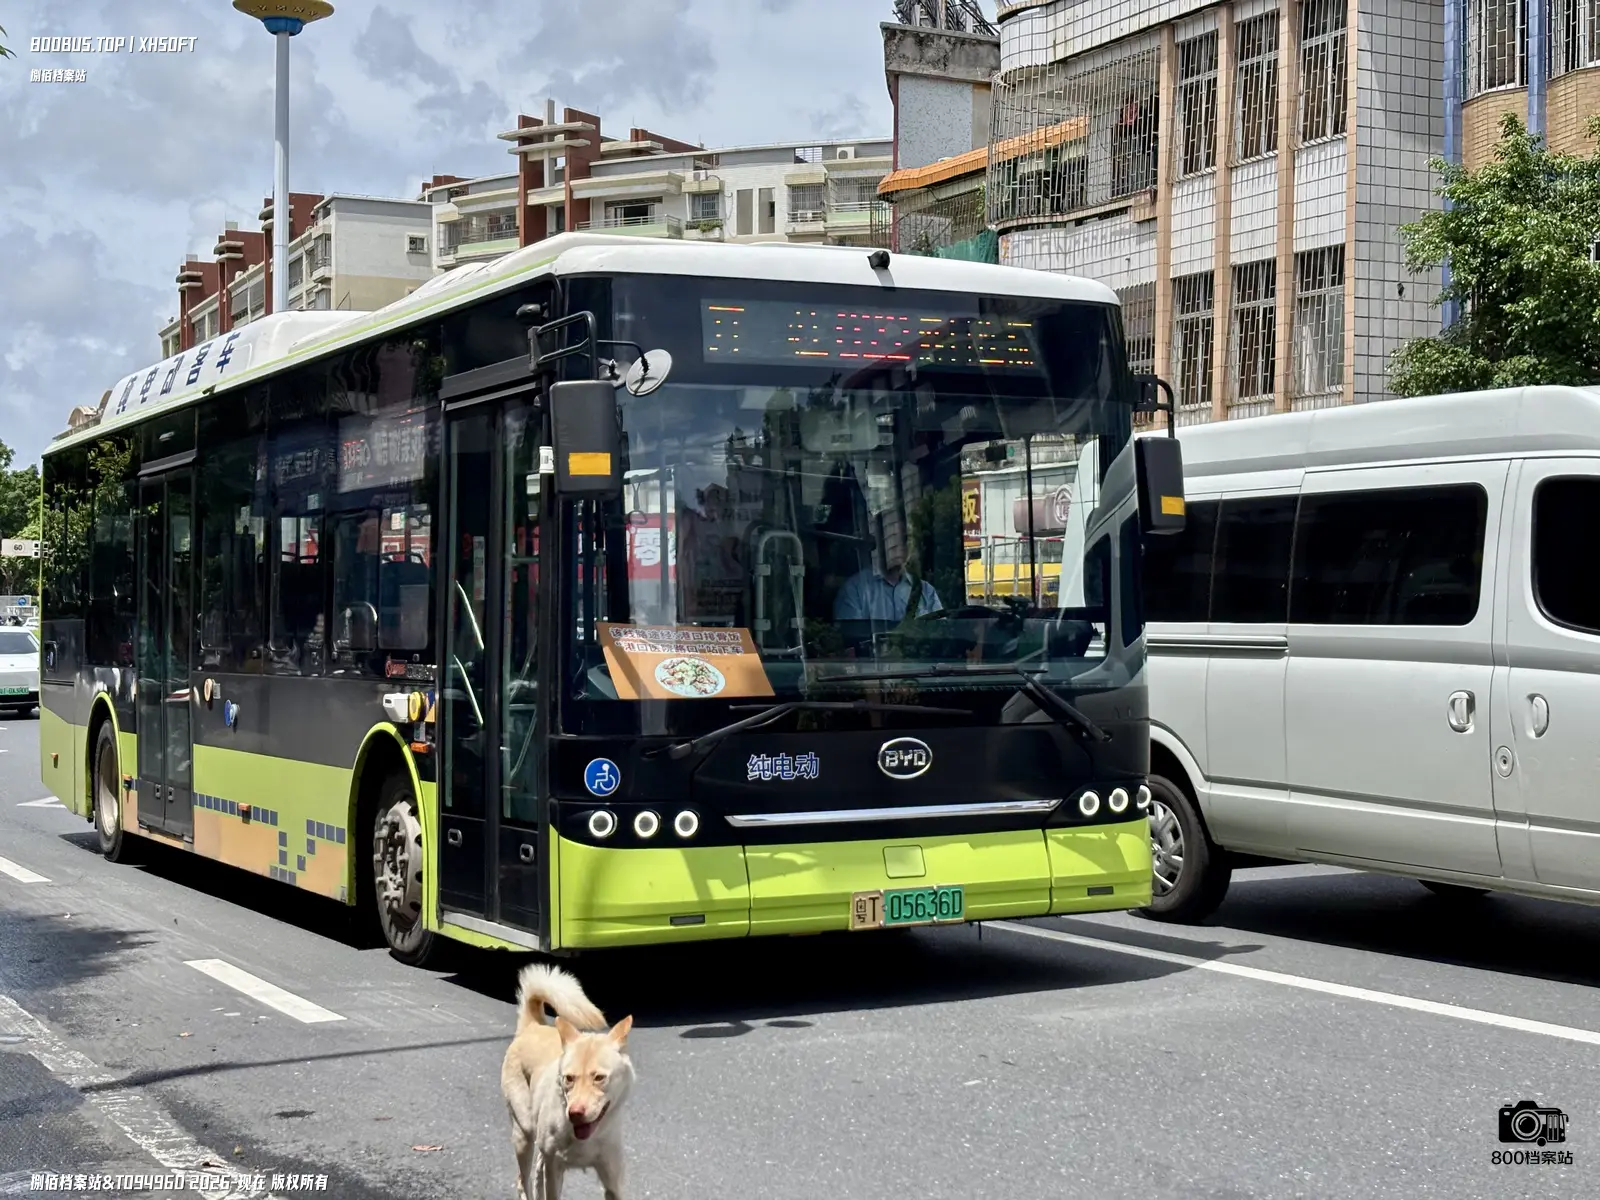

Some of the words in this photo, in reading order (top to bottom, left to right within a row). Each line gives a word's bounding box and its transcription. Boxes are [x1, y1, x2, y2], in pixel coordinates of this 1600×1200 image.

[747, 752, 820, 780] 纯电动
[884, 750, 927, 767] BYD
